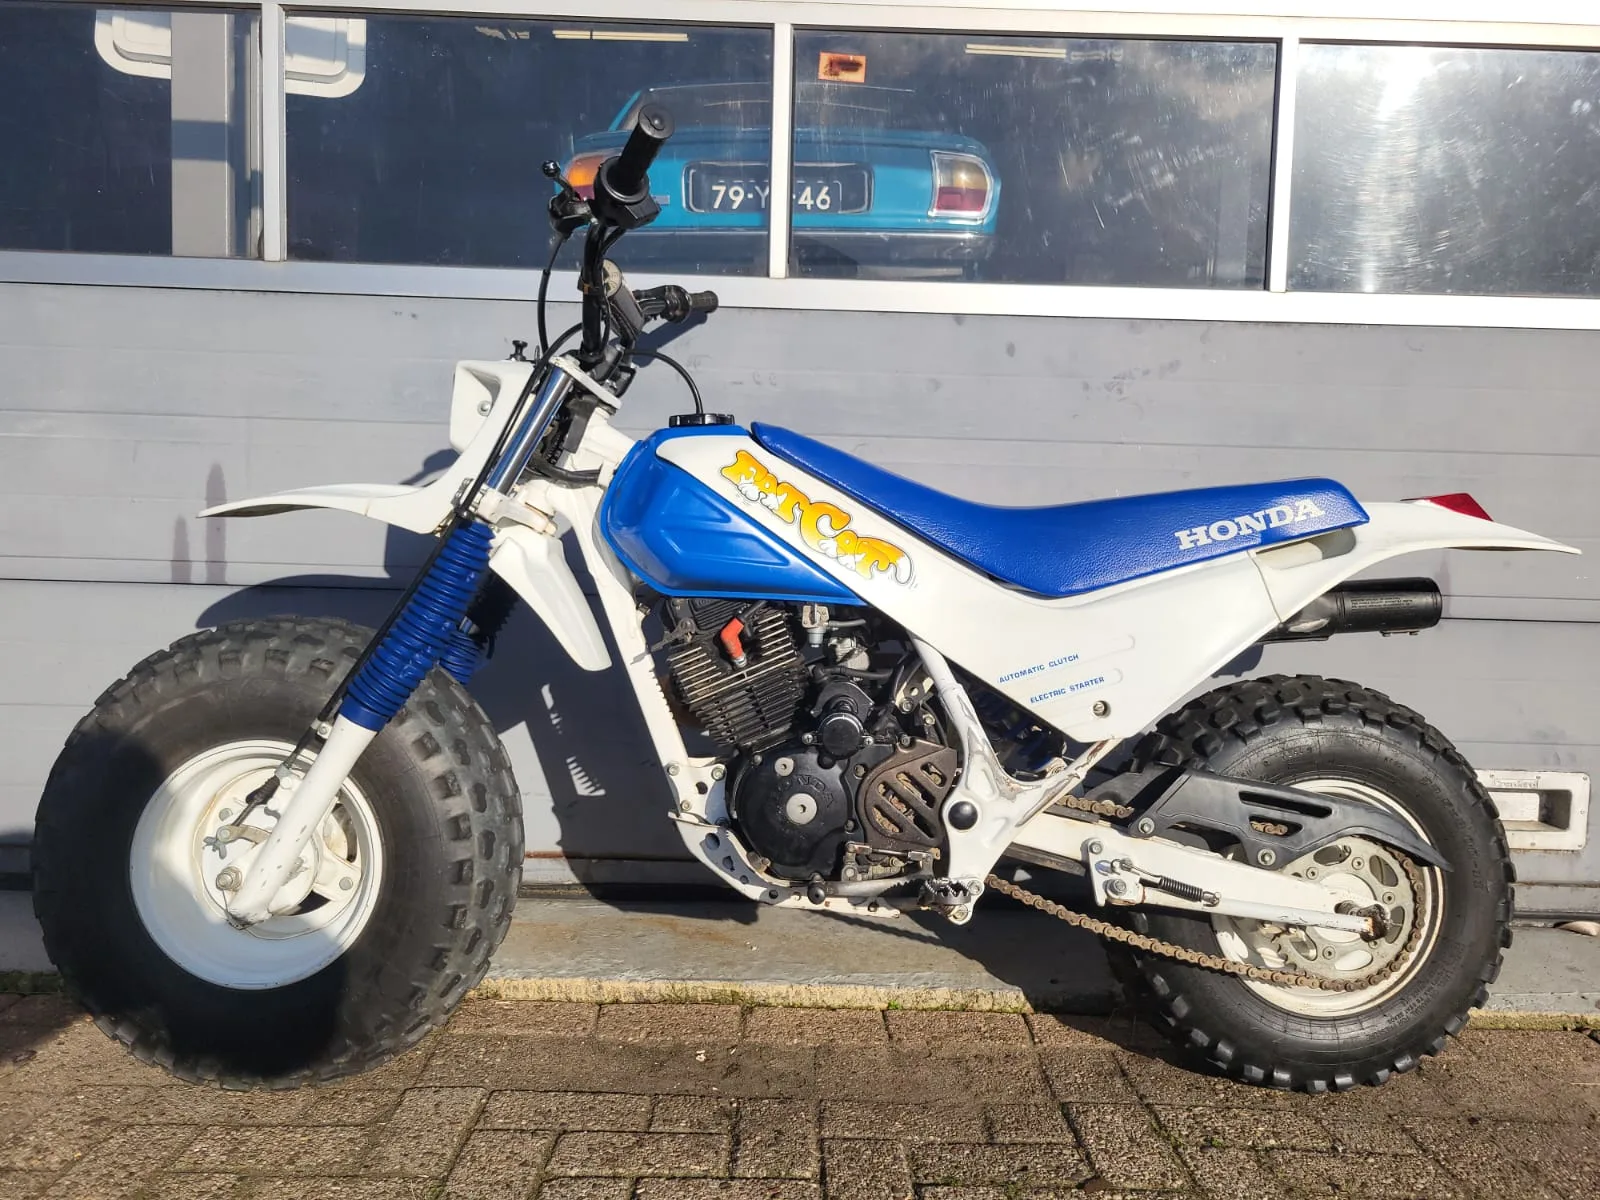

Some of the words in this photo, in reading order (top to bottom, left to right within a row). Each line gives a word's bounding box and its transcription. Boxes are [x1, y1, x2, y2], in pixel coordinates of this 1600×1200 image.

[711, 184, 831, 210] 79-Y-46
[1175, 498, 1326, 550] HONDA
[999, 664, 1045, 684] AUTOMATIC
[1048, 653, 1080, 668] CLUTCH
[1030, 688, 1066, 704] ELECTRIC
[1069, 676, 1105, 692] STARTER
